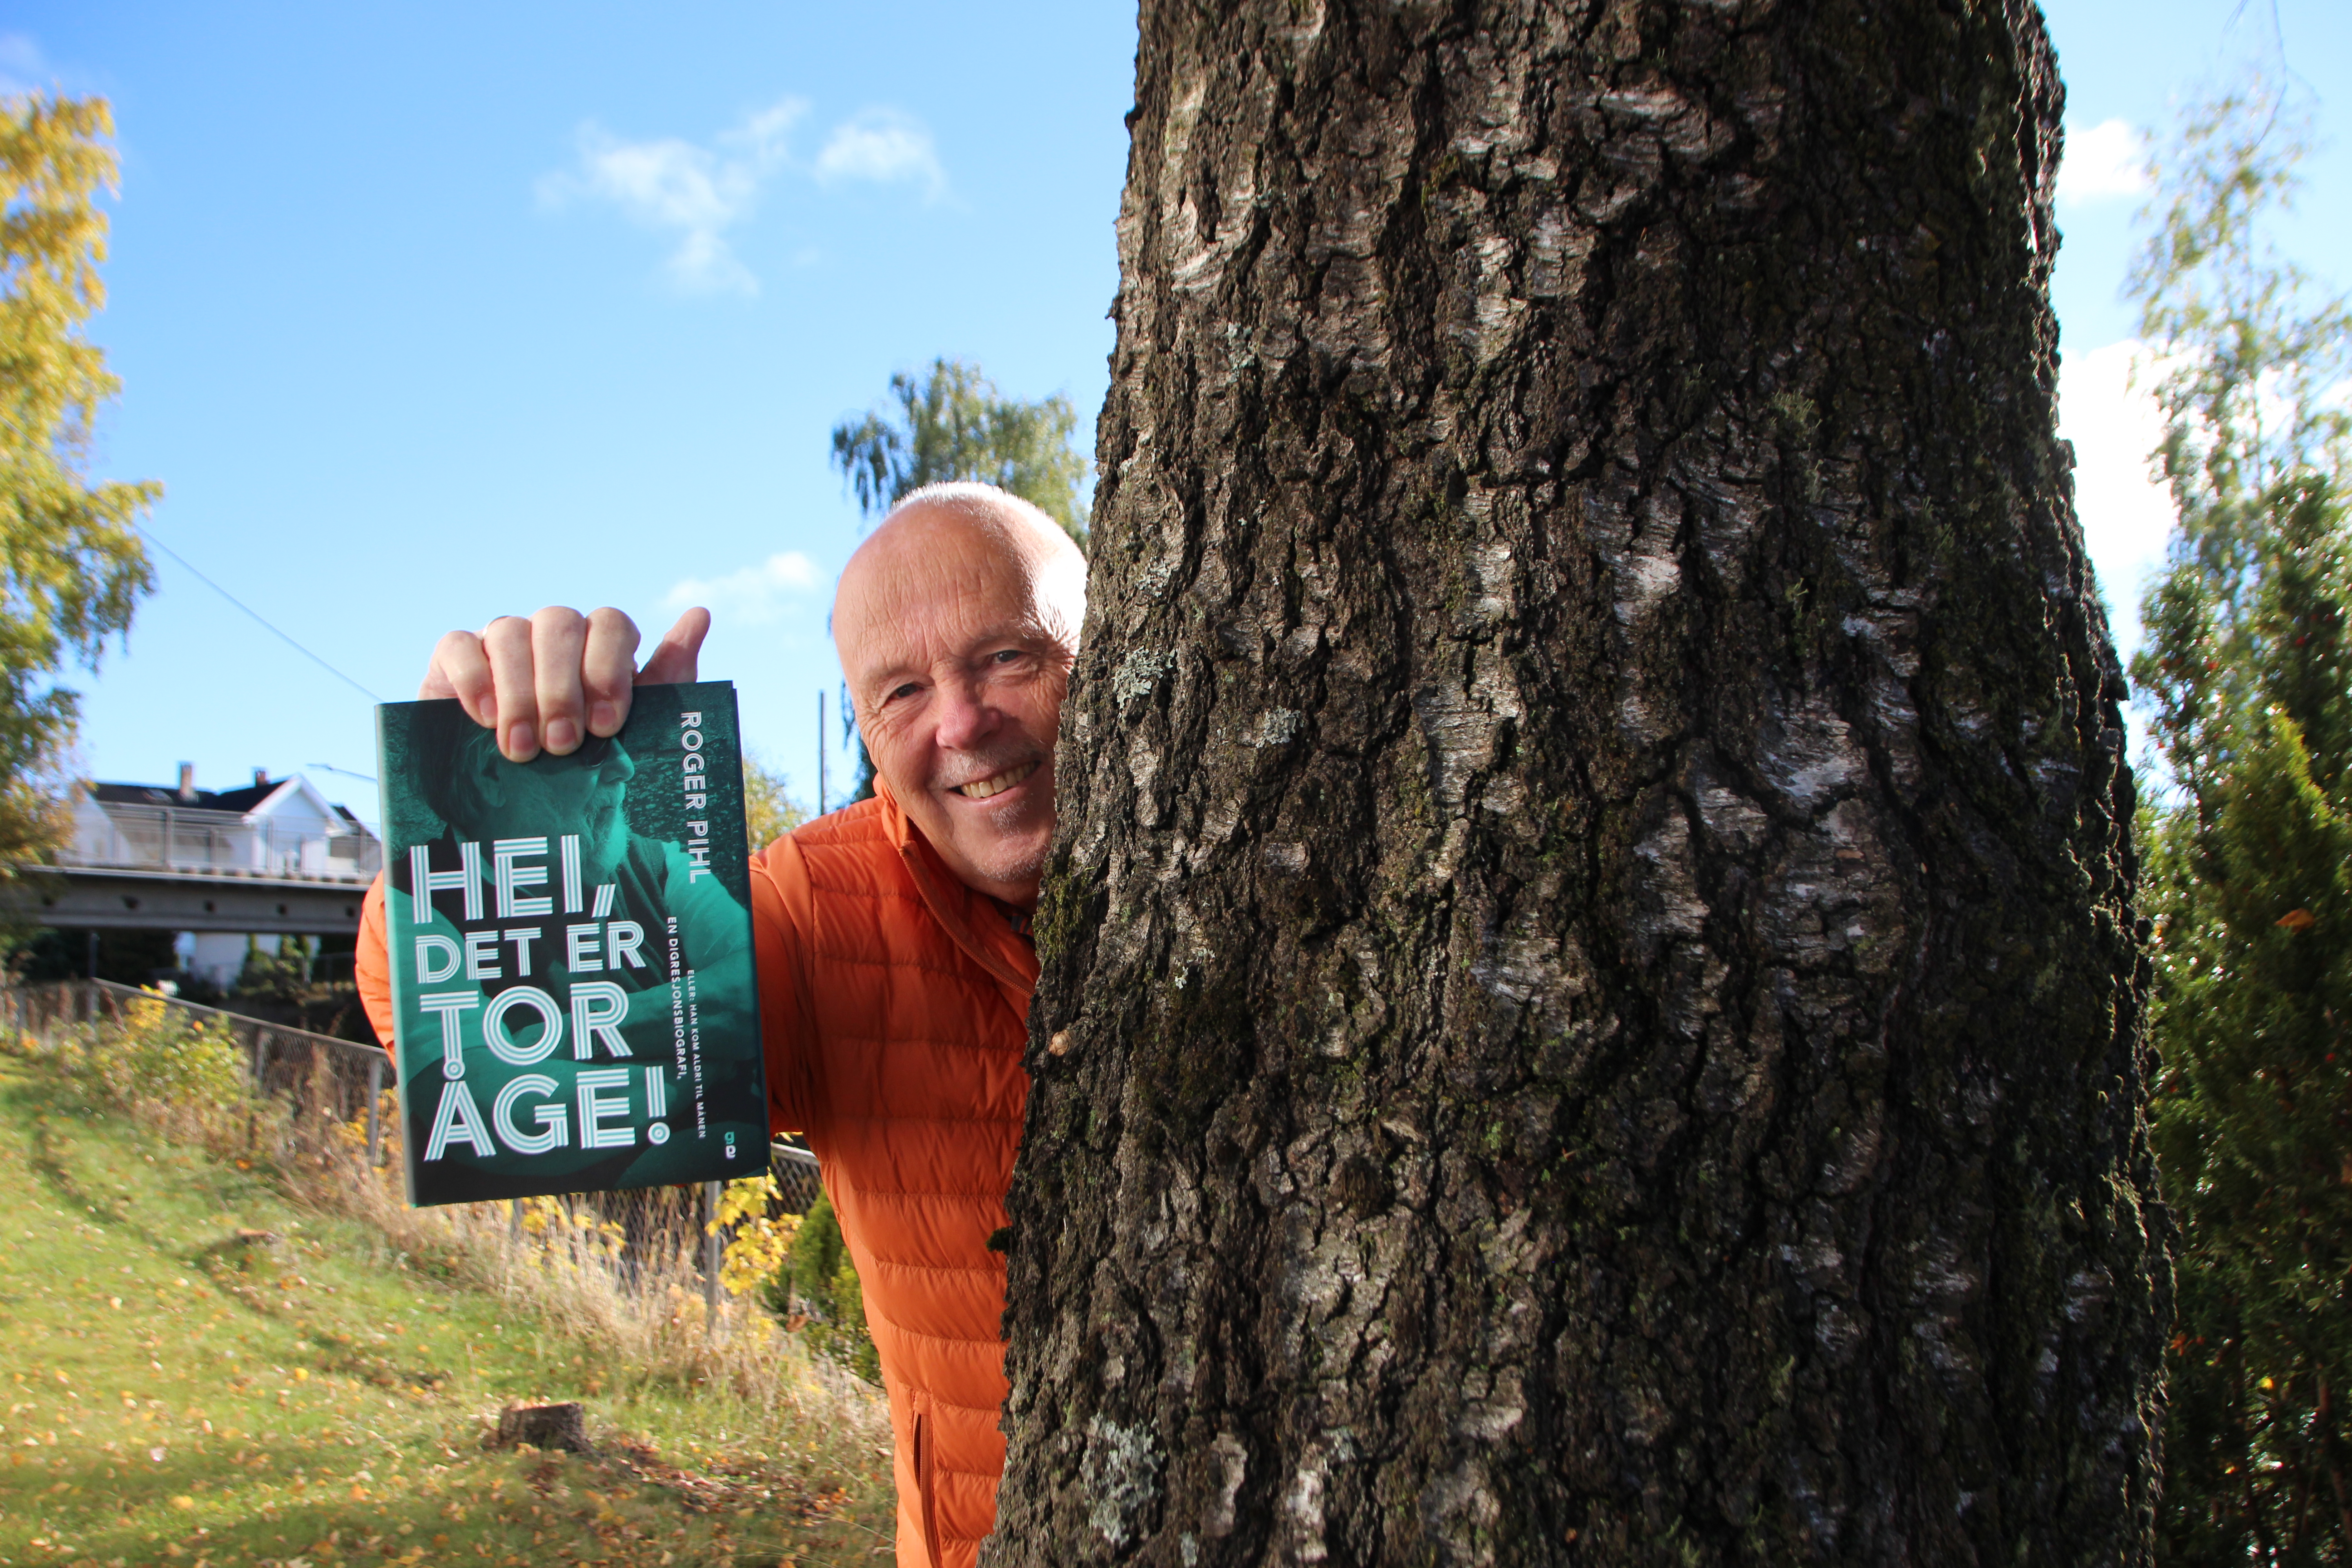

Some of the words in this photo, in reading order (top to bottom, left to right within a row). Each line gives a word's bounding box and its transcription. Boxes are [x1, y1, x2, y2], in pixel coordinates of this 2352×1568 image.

[681, 712, 707, 810] ROGER
[687, 821, 711, 884] PIHL
[410, 834, 617, 924] HEI,
[667, 916, 677, 934] EN
[415, 926, 542, 985] DET
[567, 920, 647, 973] ER
[669, 938, 687, 1080] DIGRESJONSBIOGRAFI,
[687, 970, 696, 1001] ELLER:
[420, 980, 633, 1066] TOR
[689, 1004, 697, 1025] HAN
[691, 1028, 700, 1050] KOM
[693, 1054, 701, 1081] ALDRI
[695, 1084, 703, 1099] TIL
[423, 1059, 671, 1161] ÅGE!
[696, 1102, 706, 1138] MÅNEN
